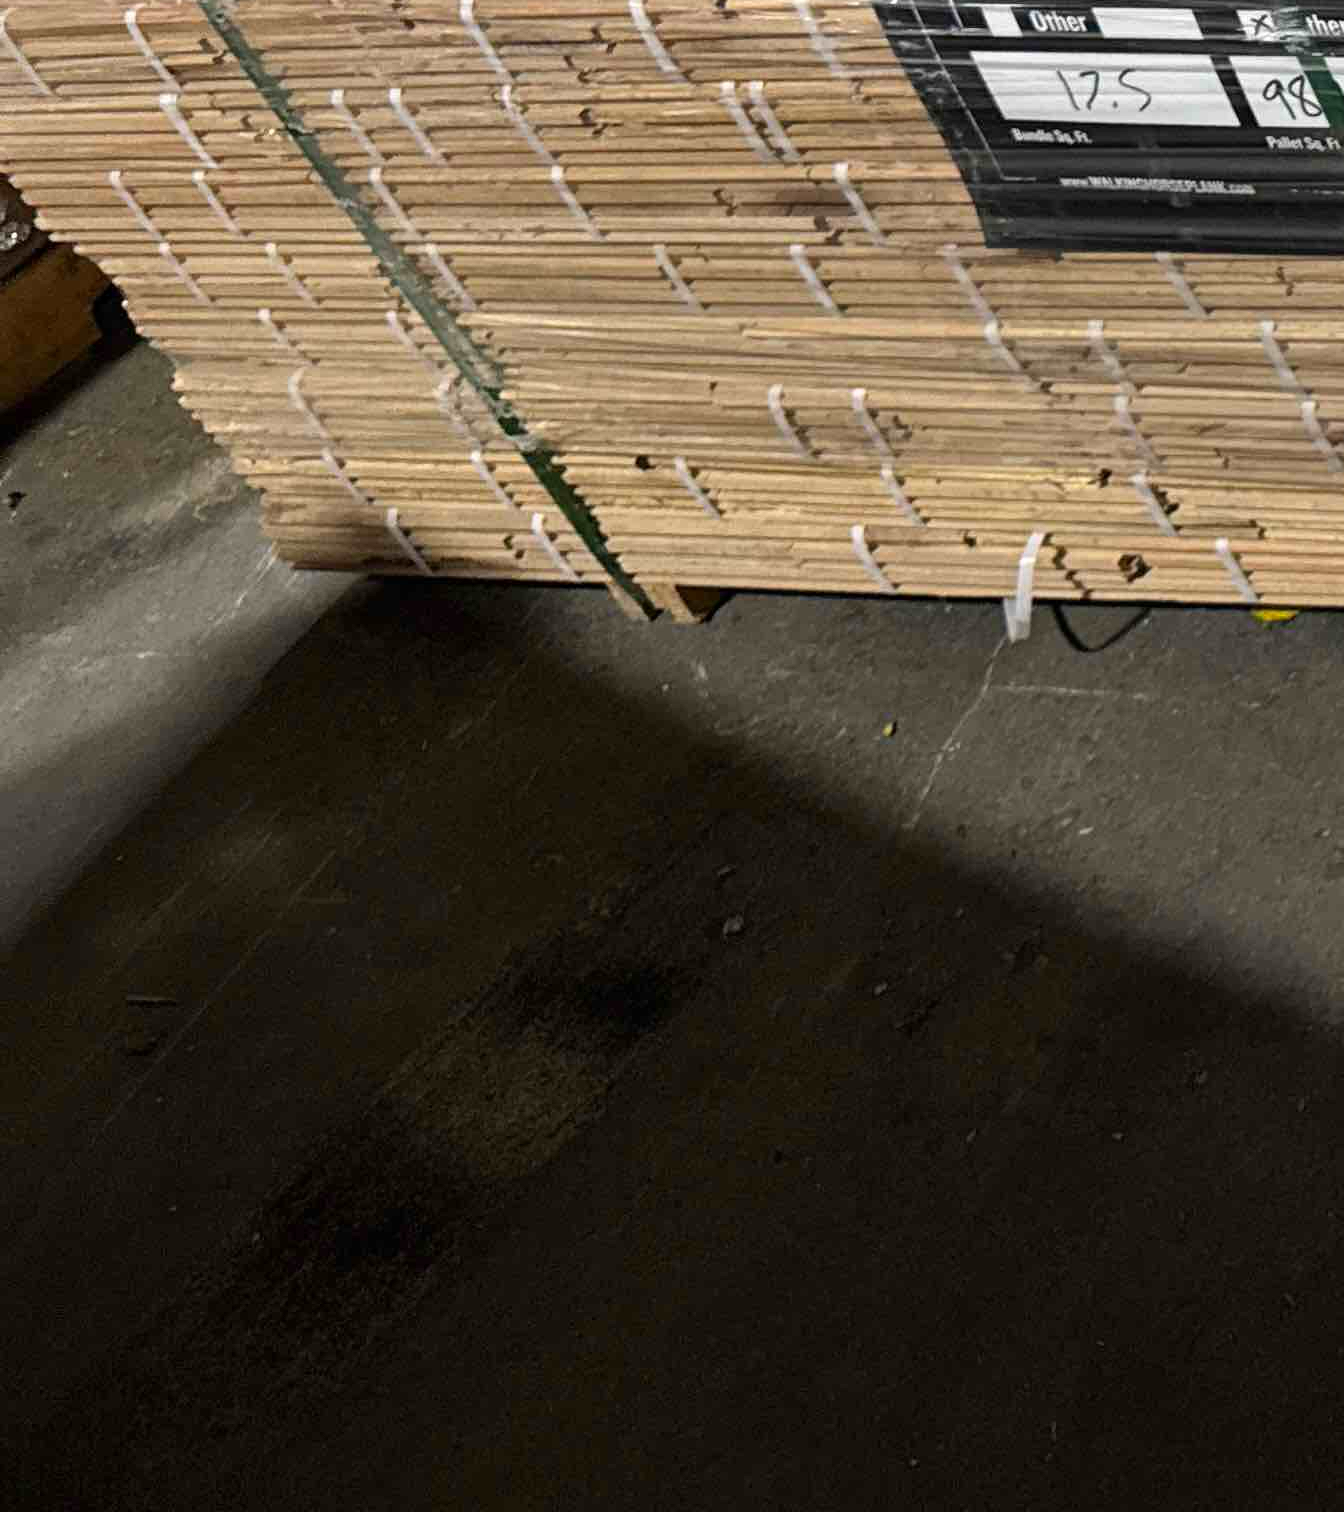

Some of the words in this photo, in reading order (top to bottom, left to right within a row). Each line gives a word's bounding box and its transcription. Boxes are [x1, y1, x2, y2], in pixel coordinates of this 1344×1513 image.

[1029, 9, 1087, 32] Other
[1057, 68, 1152, 112] 17.5
[1265, 135, 1304, 150] Pallet
